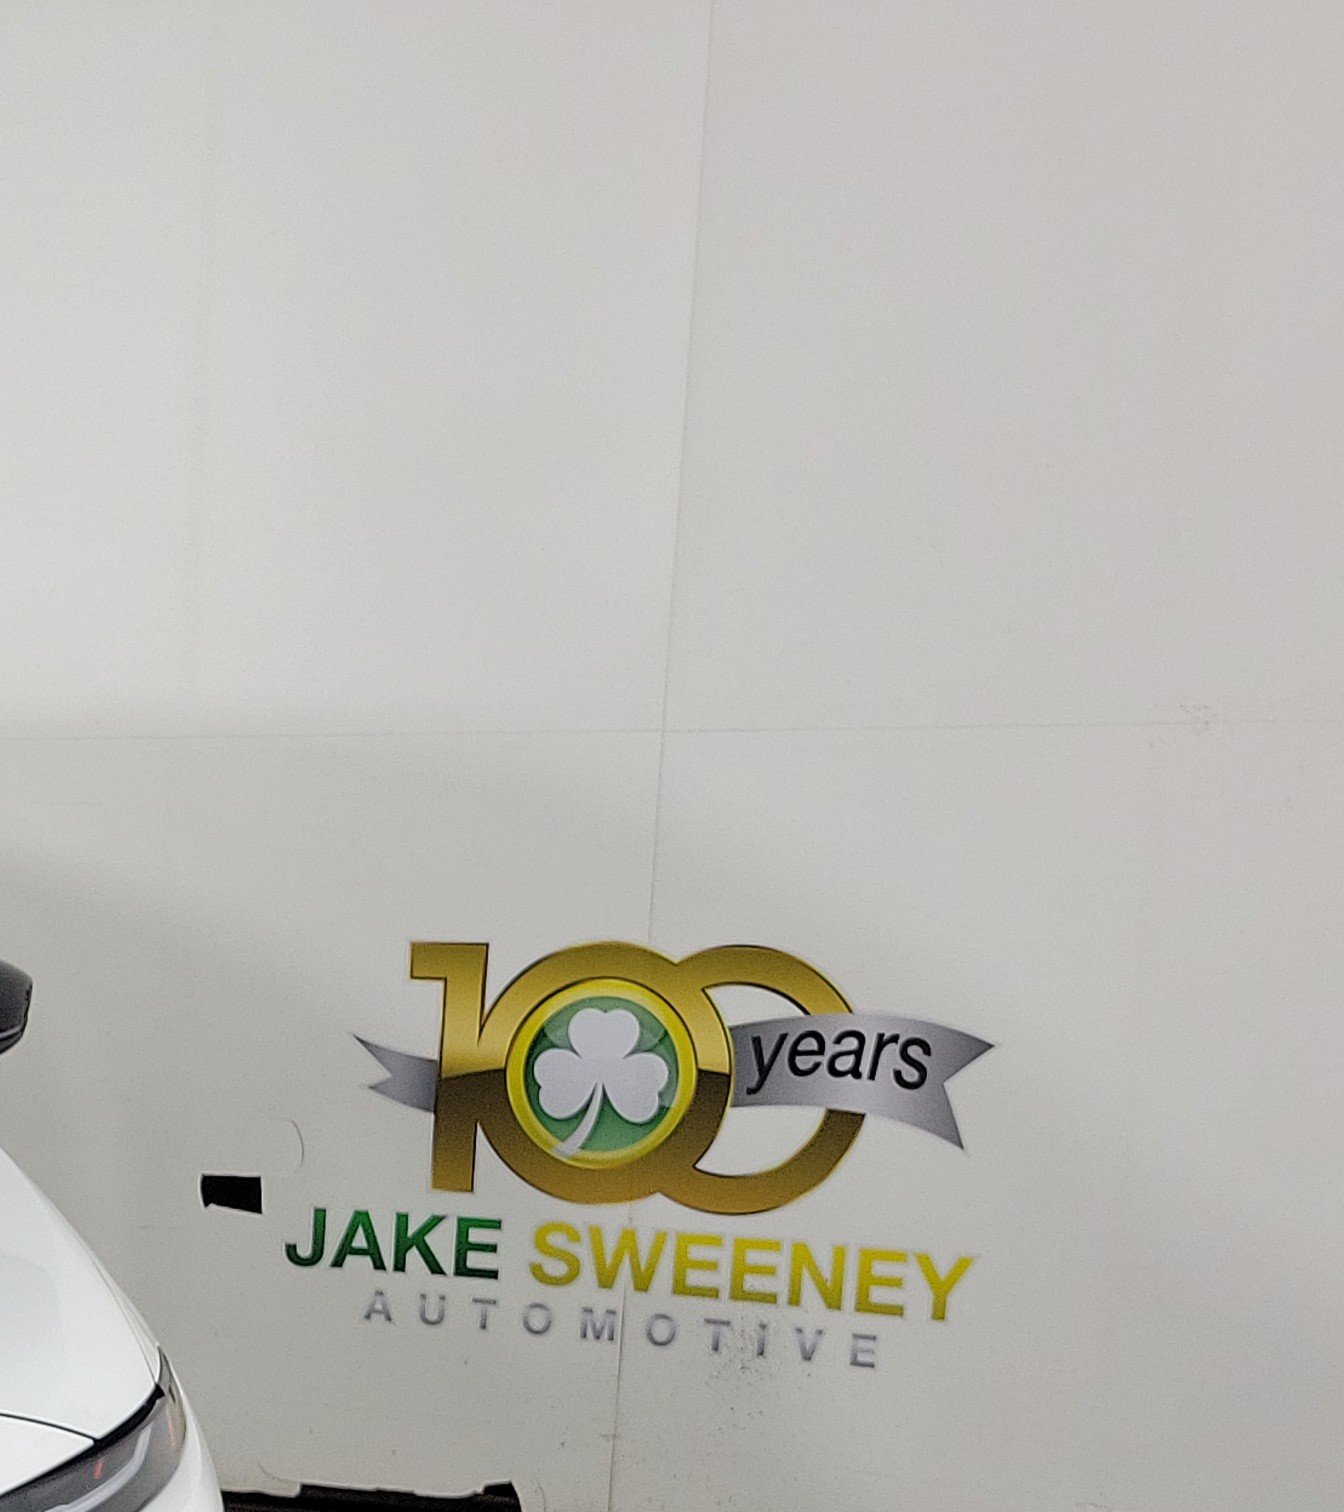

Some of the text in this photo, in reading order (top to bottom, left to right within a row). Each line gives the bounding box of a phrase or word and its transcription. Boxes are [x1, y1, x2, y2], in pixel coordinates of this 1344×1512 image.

[408, 940, 934, 1216] 100 years
[283, 1206, 977, 1323] JAKE SWEENEY
[363, 1289, 880, 1370] AUTOMOTIVE
